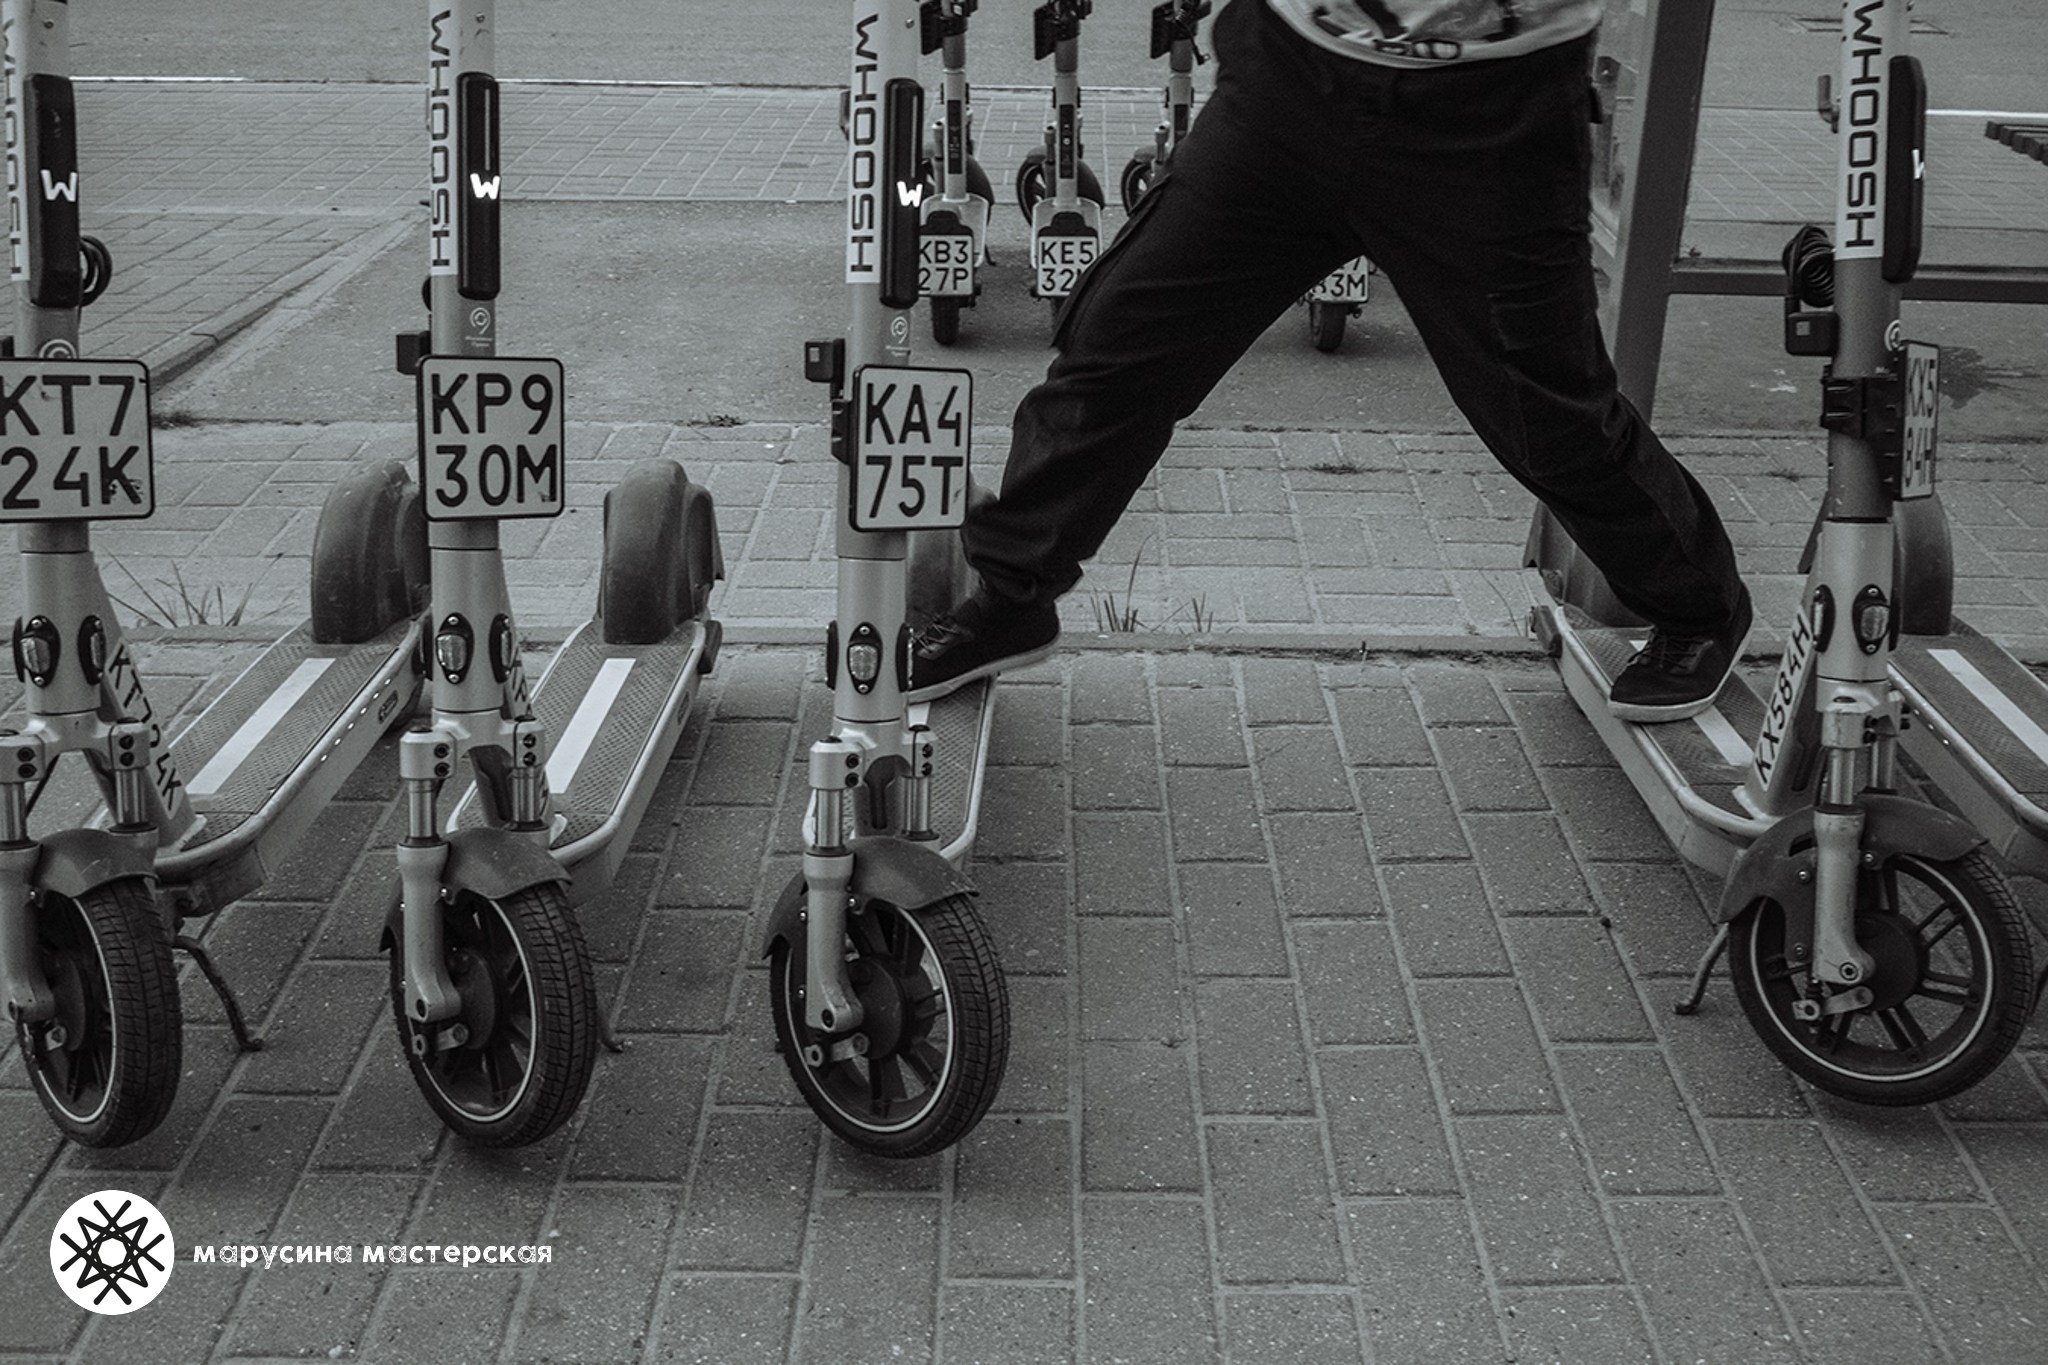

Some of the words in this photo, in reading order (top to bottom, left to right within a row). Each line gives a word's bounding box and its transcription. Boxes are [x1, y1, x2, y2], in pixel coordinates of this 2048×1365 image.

[431, 9, 450, 267] WHOOSH
[850, 13, 878, 273] WHOOSH
[1845, 0, 1884, 248] WHOOSH
[40, 169, 78, 202] W
[470, 173, 500, 200] W
[897, 181, 923, 208] W
[919, 267, 969, 292] 27P
[1041, 241, 1094, 265] KE5
[1041, 267, 1083, 292] 32
[0, 374, 135, 436] KT7
[431, 373, 553, 435] KP9
[865, 382, 961, 447] KA4
[1, 445, 142, 510] 24K
[435, 443, 557, 508] 30M
[865, 455, 964, 518] 75T
[1755, 613, 1811, 784] KX584H
